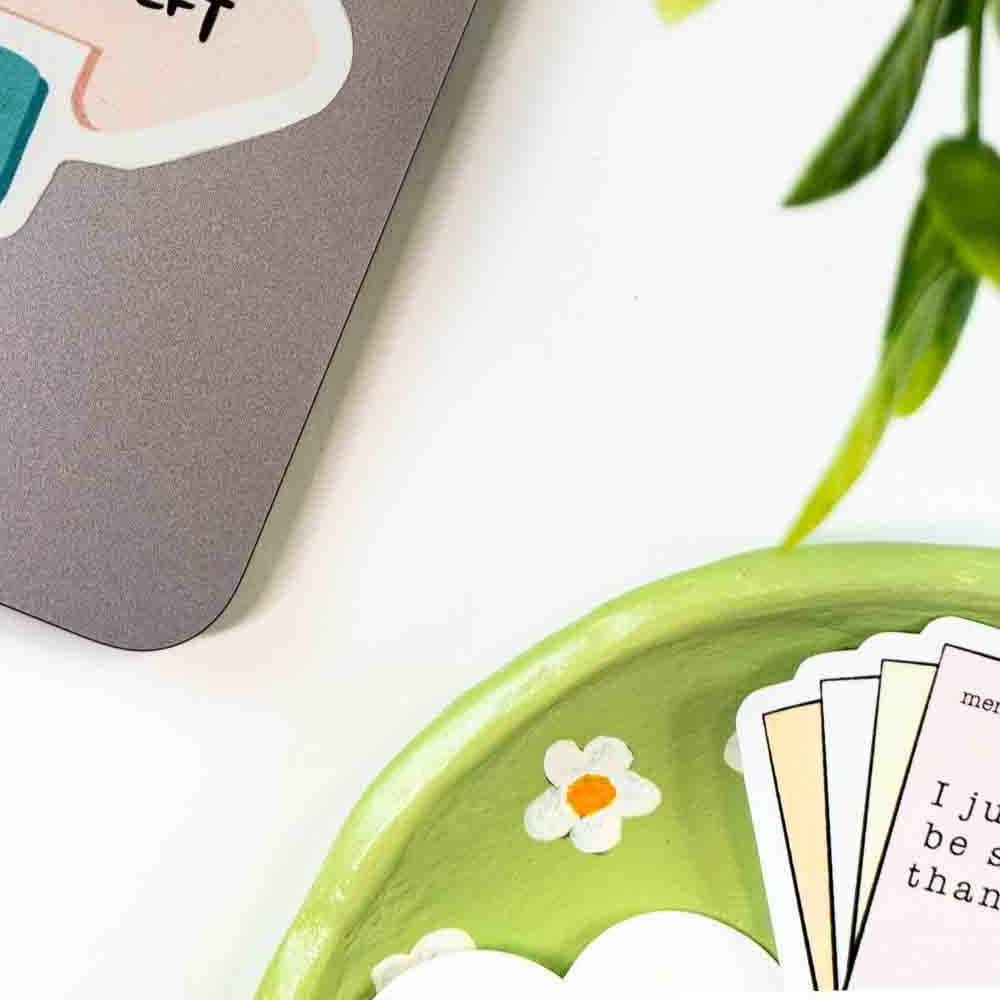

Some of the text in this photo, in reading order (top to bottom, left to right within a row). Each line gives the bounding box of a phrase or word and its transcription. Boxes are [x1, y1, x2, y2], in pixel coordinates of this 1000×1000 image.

[930, 779, 950, 808] I
[922, 820, 969, 857] be
[907, 862, 1000, 911] than
